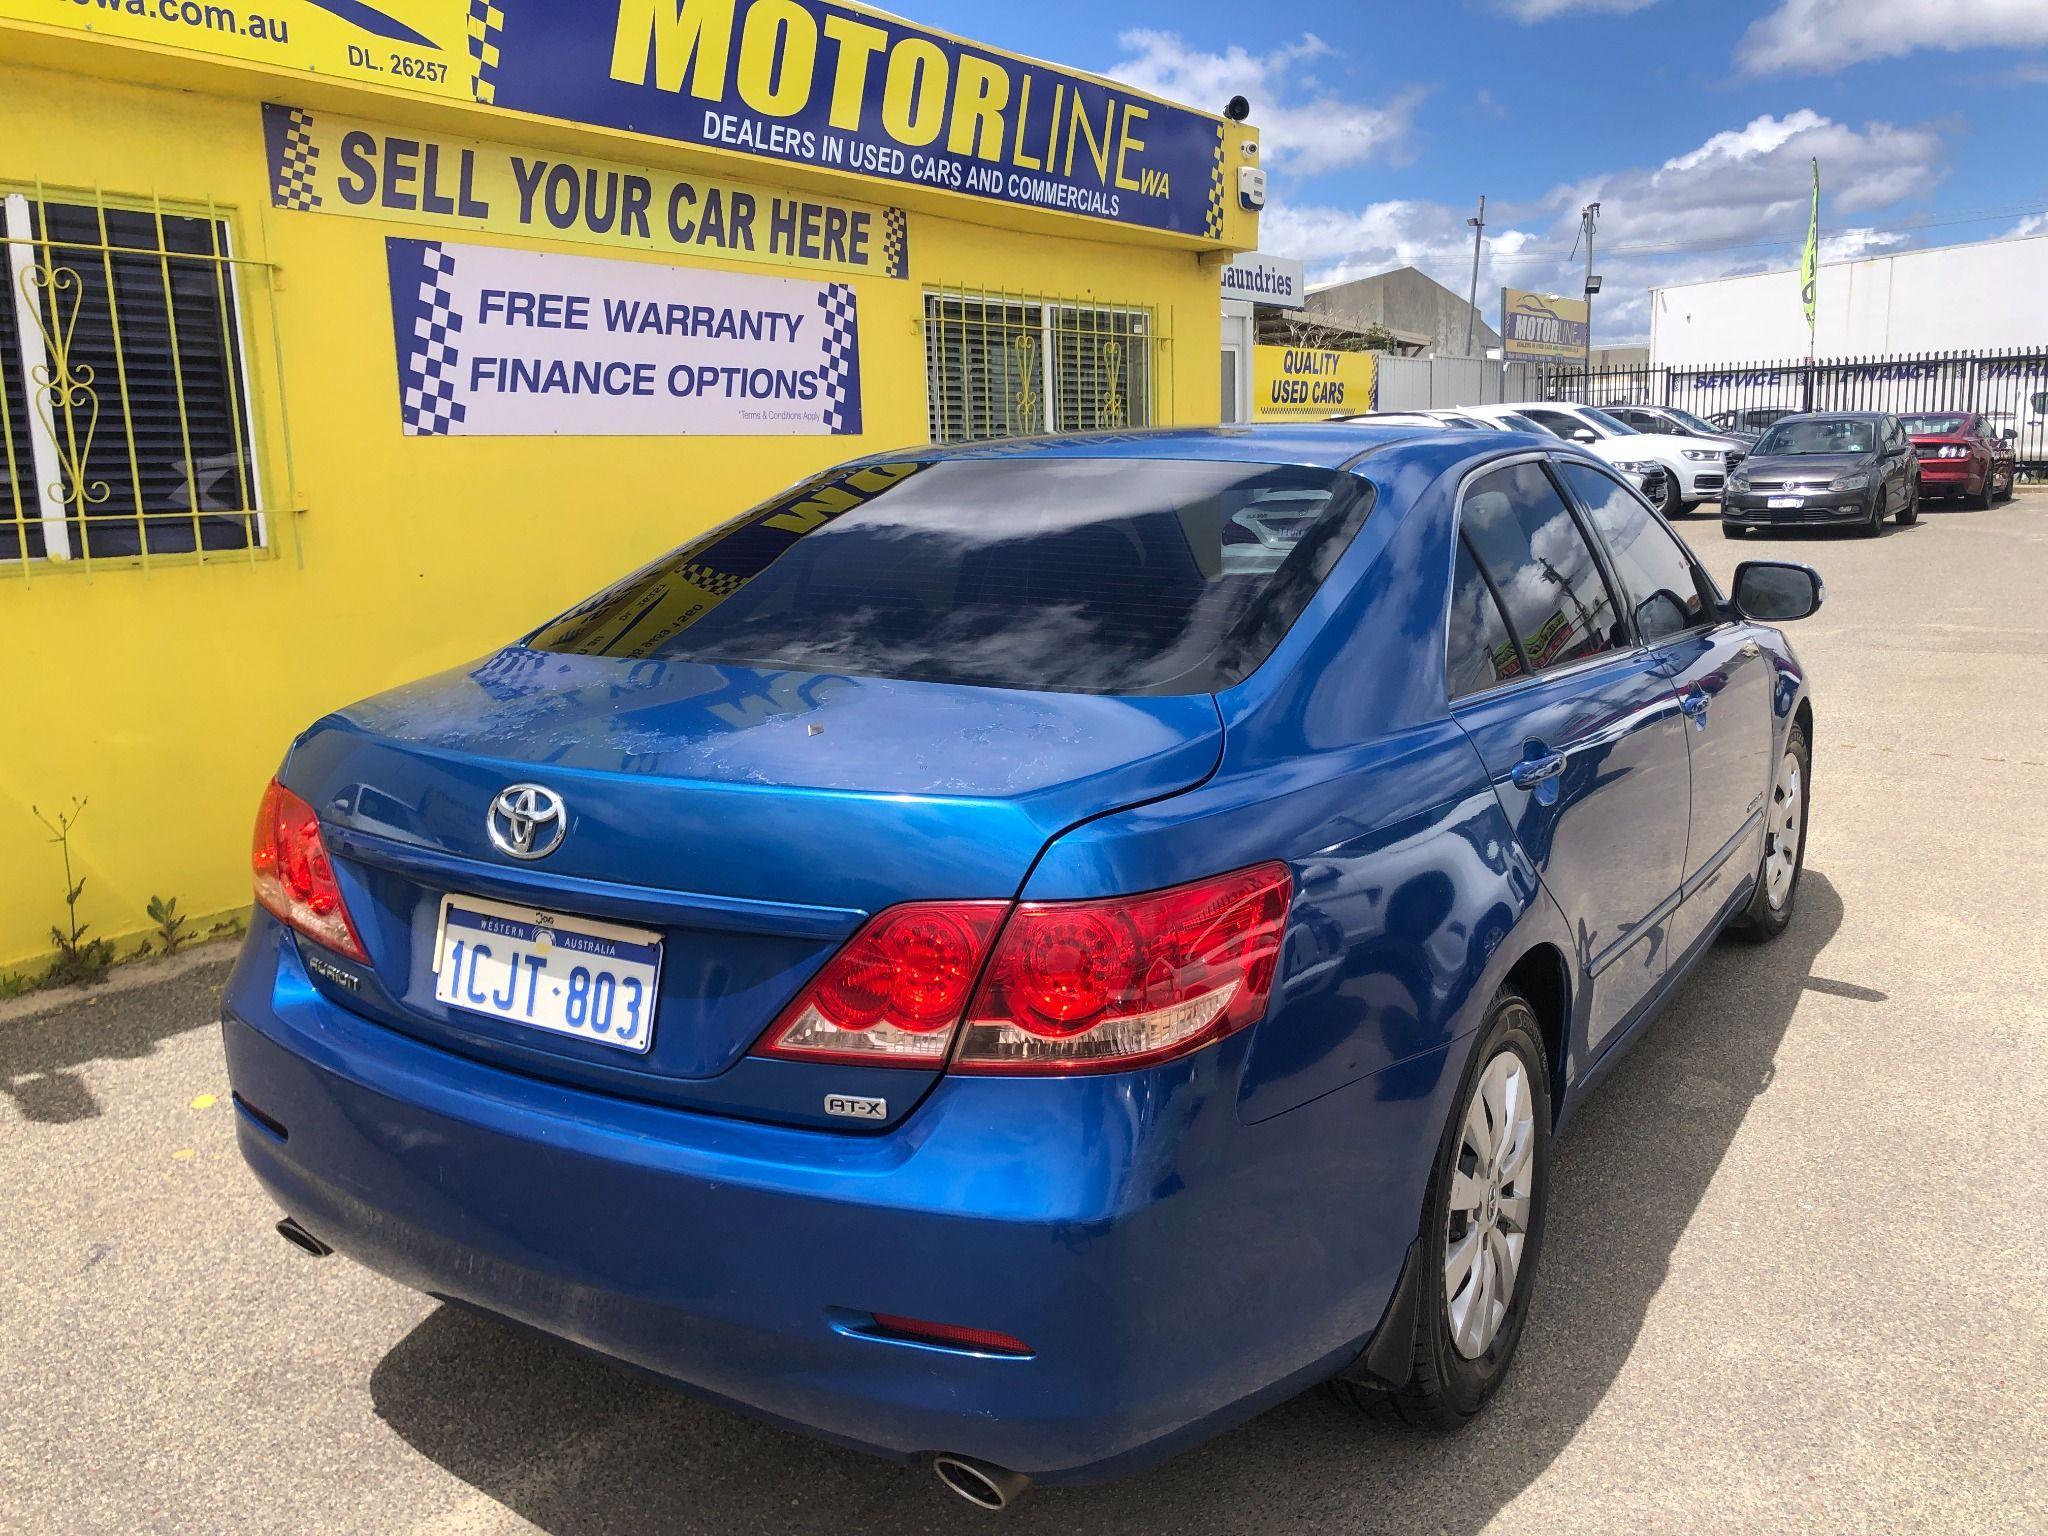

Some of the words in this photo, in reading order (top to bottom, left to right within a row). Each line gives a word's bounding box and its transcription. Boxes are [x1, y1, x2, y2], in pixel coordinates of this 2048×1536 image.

[348, 45, 384, 71] DL.
[390, 54, 448, 83] 26257
[703, 110, 816, 158] DEALERS
[821, 135, 843, 164] IN
[850, 141, 905, 175] USED
[910, 154, 962, 187] CARS
[965, 166, 1003, 194] AND
[1008, 174, 1120, 217] COMMERCIALS
[337, 131, 489, 219] SELL
[510, 156, 651, 239] YOUR
[668, 182, 755, 251] CAR
[769, 198, 871, 265] HERE
[478, 289, 590, 330] FREE
[603, 298, 804, 343] WARRANTY
[470, 356, 656, 396] FINANCE
[667, 364, 818, 400] OPTIONS
[1283, 350, 1340, 375] QUALITY
[1271, 380, 1308, 404] USED
[1312, 381, 1344, 405] CARS
[768, 410, 801, 420] Conditions
[803, 411, 820, 422] Apply
[480, 919, 525, 938] WESTERN
[564, 937, 616, 956] AUSTRALIA
[829, 1098, 882, 1116] AT-X
